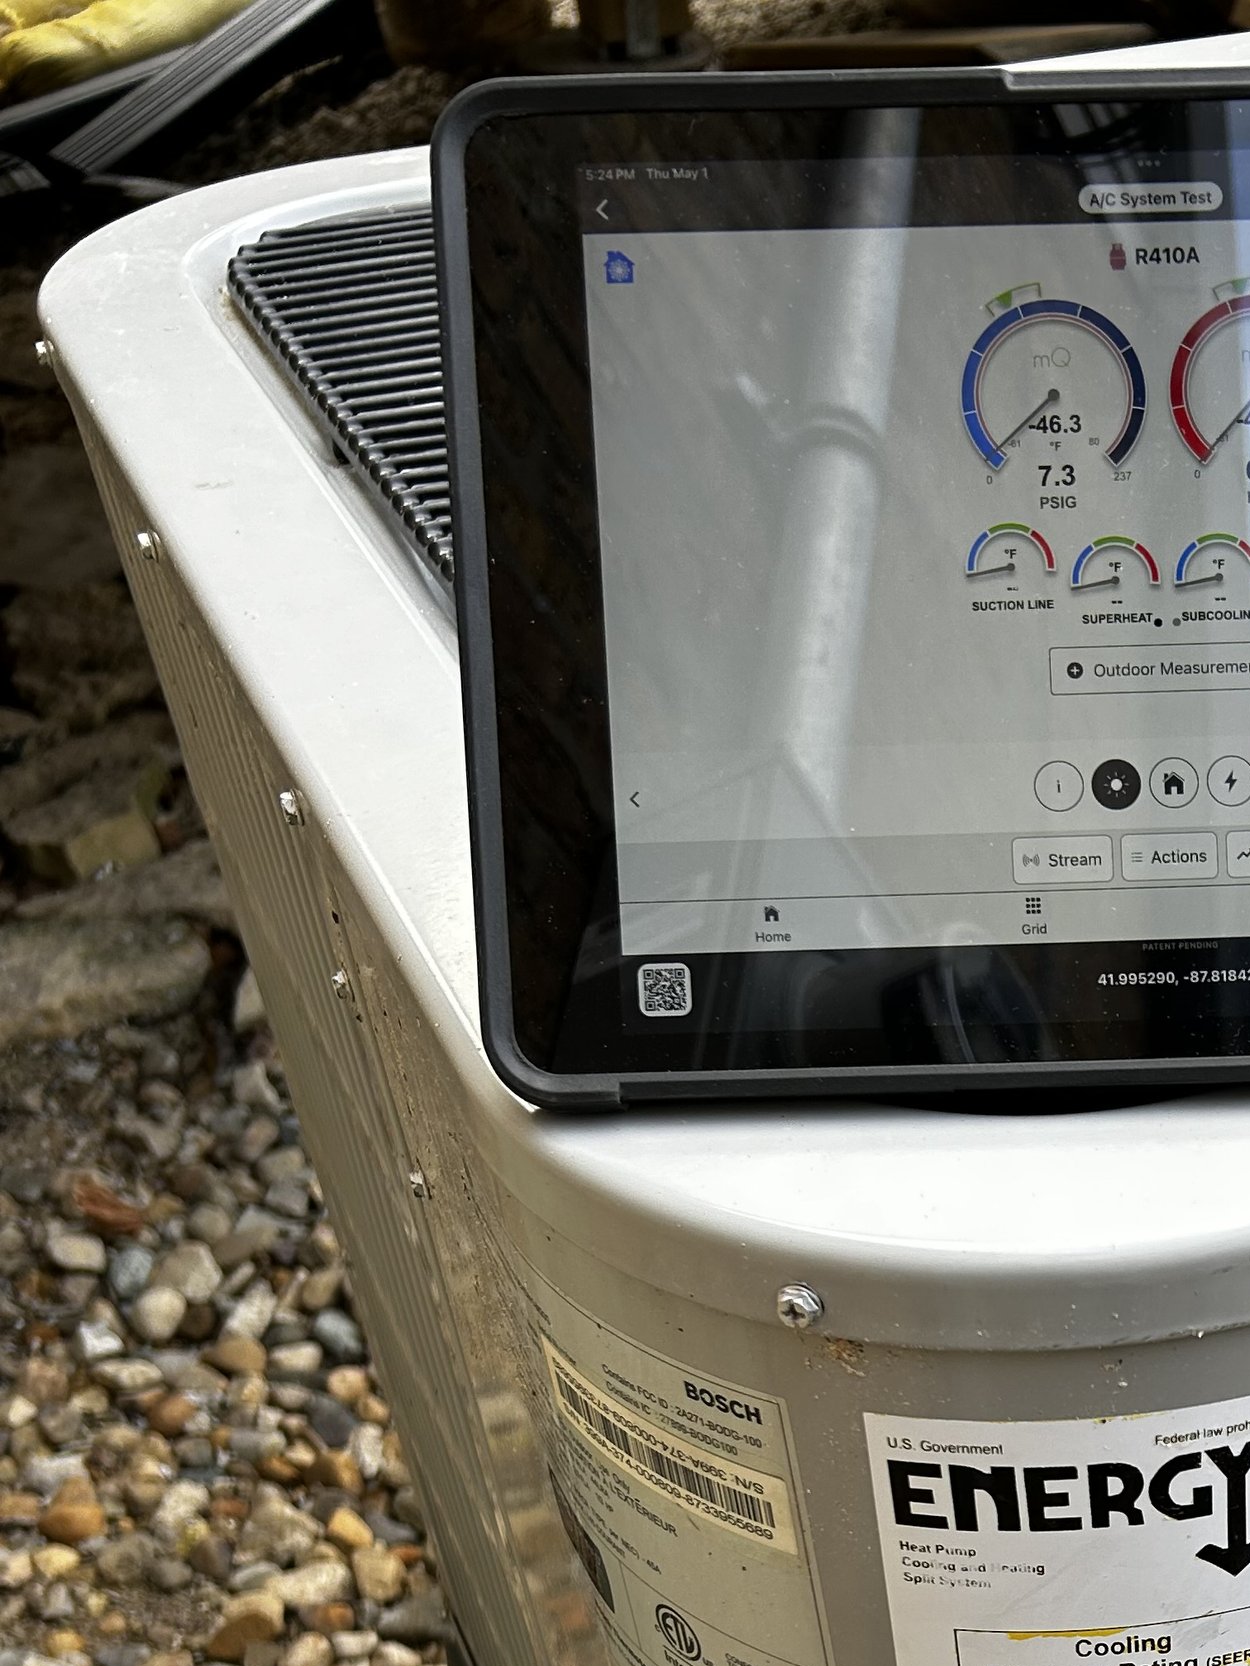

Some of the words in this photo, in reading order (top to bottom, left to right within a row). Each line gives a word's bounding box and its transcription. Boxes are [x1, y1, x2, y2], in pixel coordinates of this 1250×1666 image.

[615, 168, 636, 180] PM
[646, 168, 670, 180] Thu
[673, 168, 699, 181] May
[1089, 193, 1116, 209] A/C
[1120, 192, 1177, 208] System
[1180, 191, 1213, 205] Test
[1135, 246, 1200, 265] R410A
[1033, 347, 1071, 368] mQ
[1028, 414, 1082, 434] -46.3
[1088, 437, 1100, 447] 80
[1038, 464, 1076, 487] 7.3
[1113, 471, 1132, 482] 237
[1039, 496, 1077, 510] PSIG
[972, 601, 1025, 612] SUCTION
[1028, 599, 1055, 610] LINE
[1081, 612, 1154, 625] SUPERHEAT
[1093, 662, 1156, 678] Outdoor
[1048, 853, 1103, 868] Stream
[1151, 850, 1208, 866] Actions
[754, 931, 792, 944] Home
[1021, 923, 1048, 936] Grid
[1097, 971, 1180, 987] 41.995290,
[636, 1385, 657, 1404] FCC
[658, 1396, 669, 1410] ID
[683, 1379, 764, 1426] BOSCH
[1154, 1428, 1201, 1446] Federal
[1202, 1426, 1223, 1438] law
[920, 1440, 1004, 1456] Government
[898, 1540, 932, 1554] Heat
[1075, 1634, 1172, 1659] Cooling
